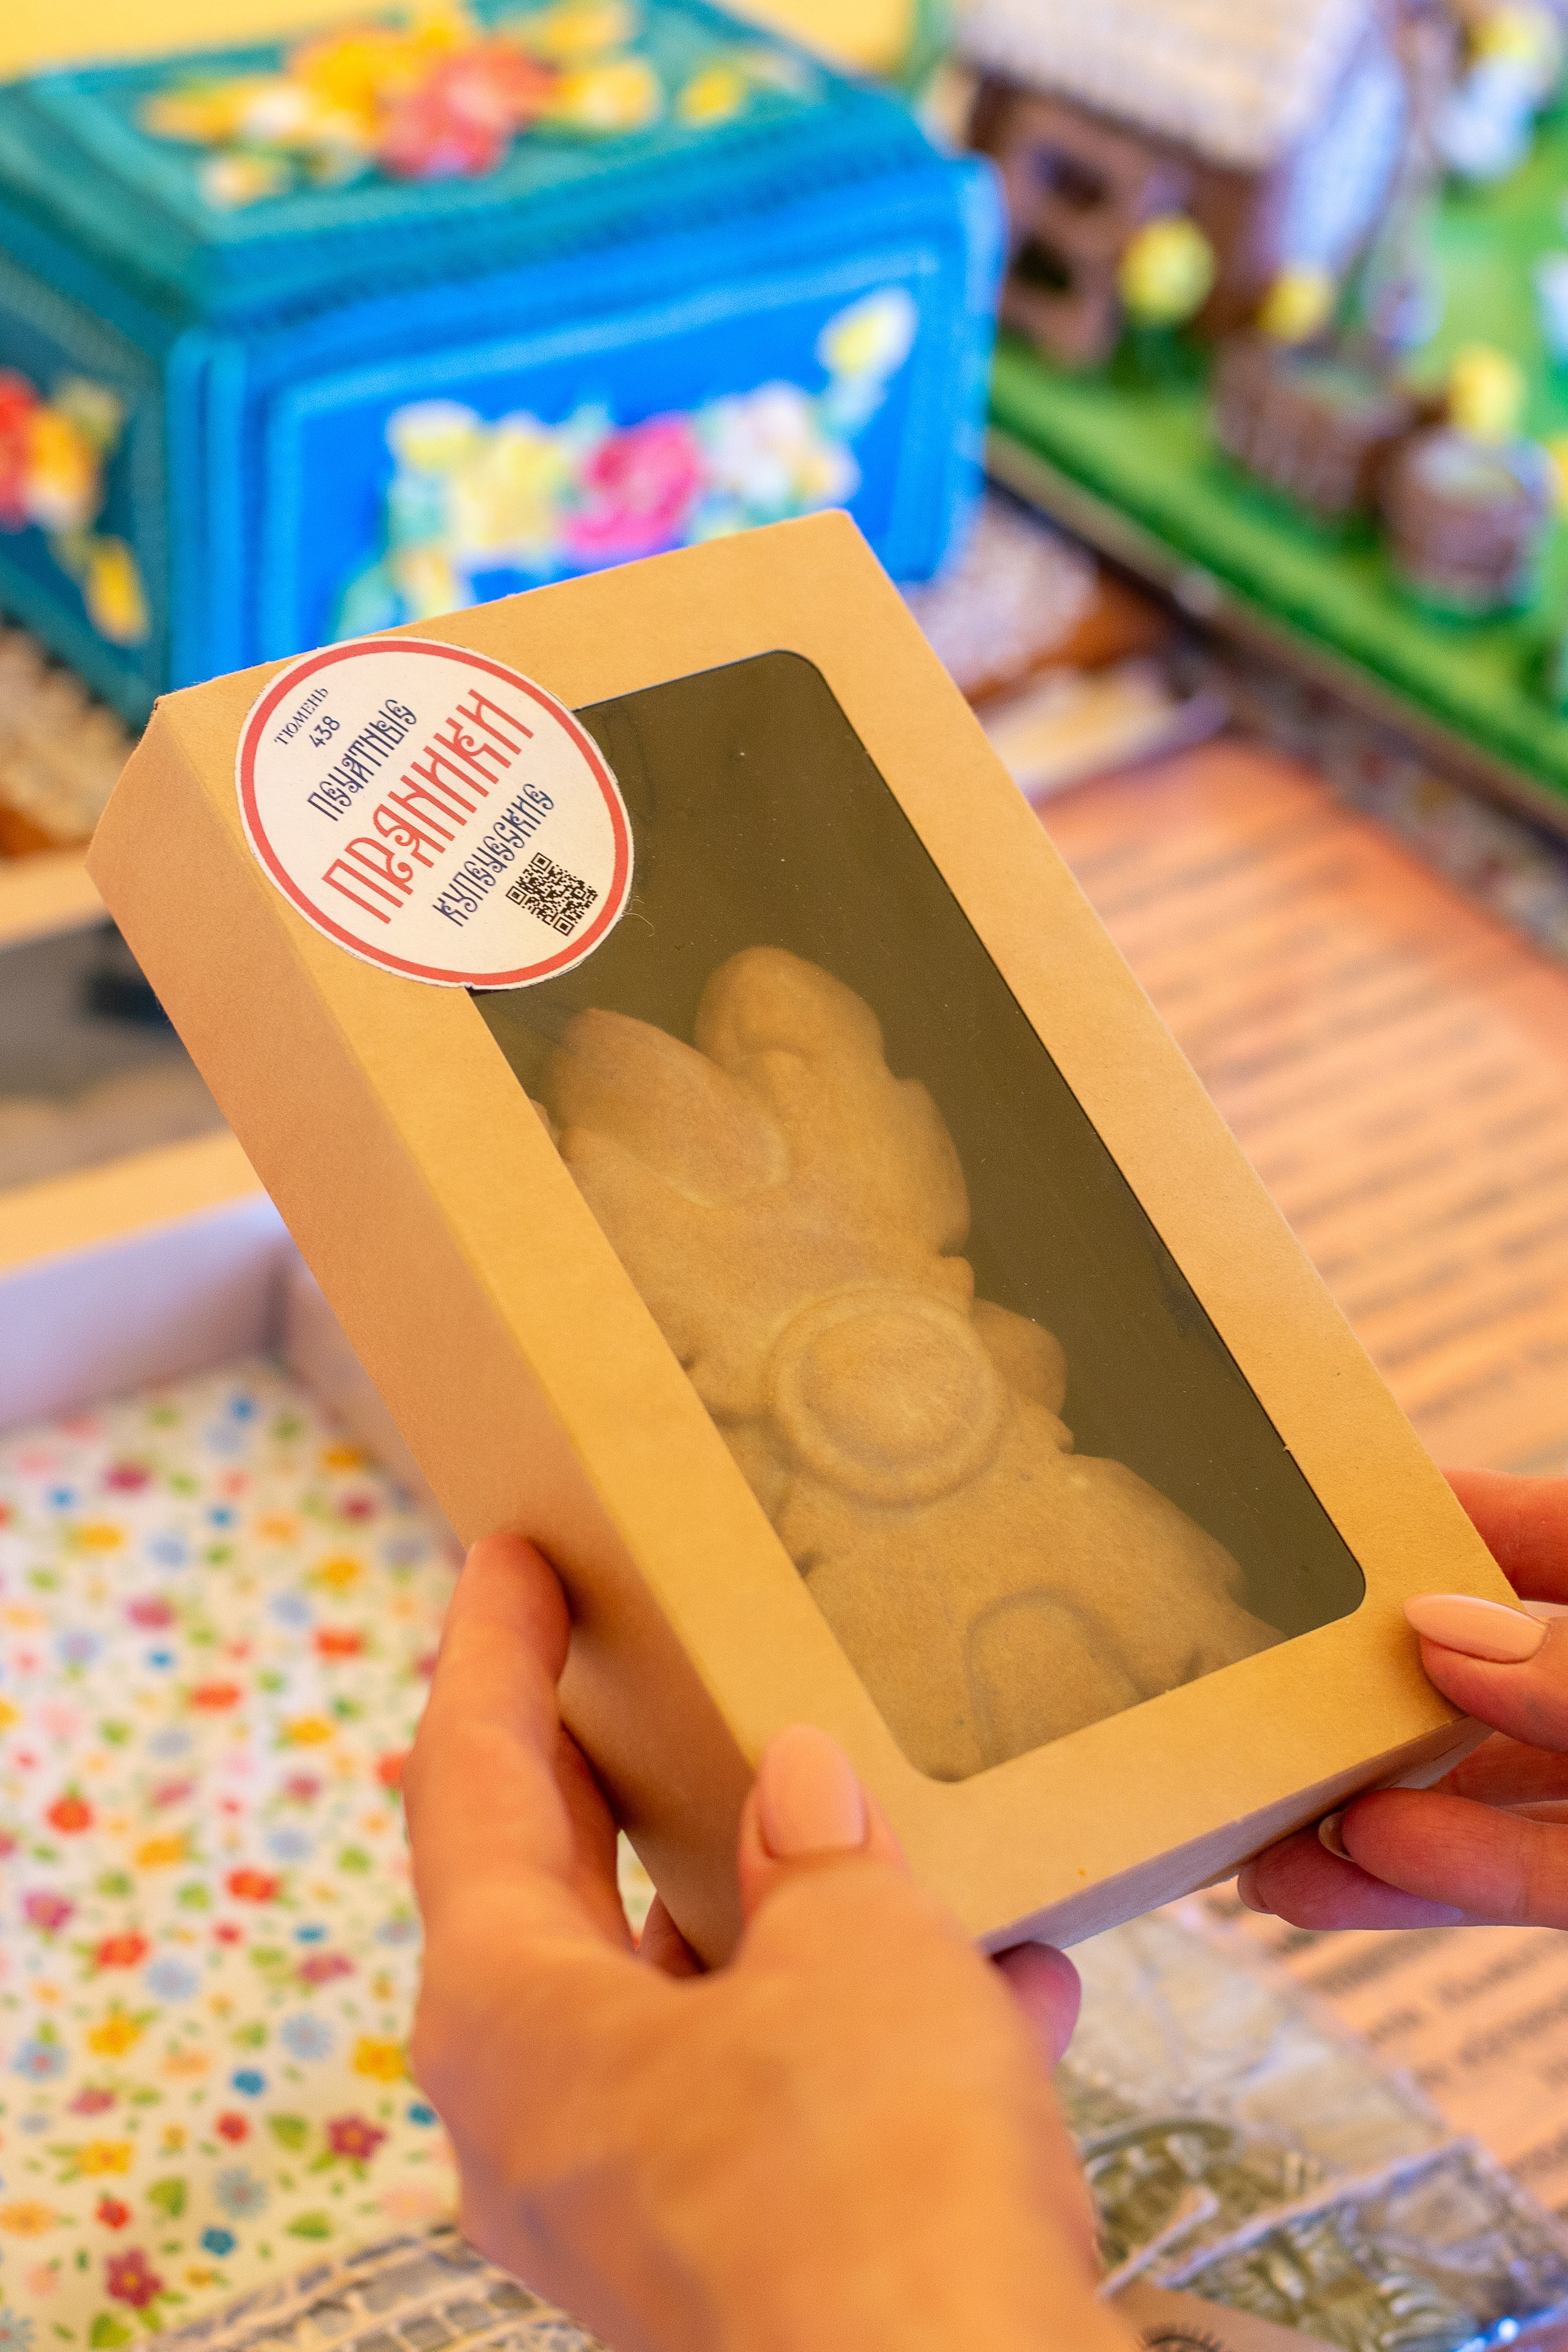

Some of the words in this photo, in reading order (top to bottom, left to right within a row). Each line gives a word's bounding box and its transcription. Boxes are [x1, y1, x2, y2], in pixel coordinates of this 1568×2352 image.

[275, 688, 328, 745] ТЮМЕНЬ
[308, 699, 416, 821] ПЕЧАТНЫЕ
[309, 716, 340, 748] 438
[322, 689, 534, 923] ПРЯНИКИ
[432, 783, 554, 926] КУПЕЧЕСКИЕ
